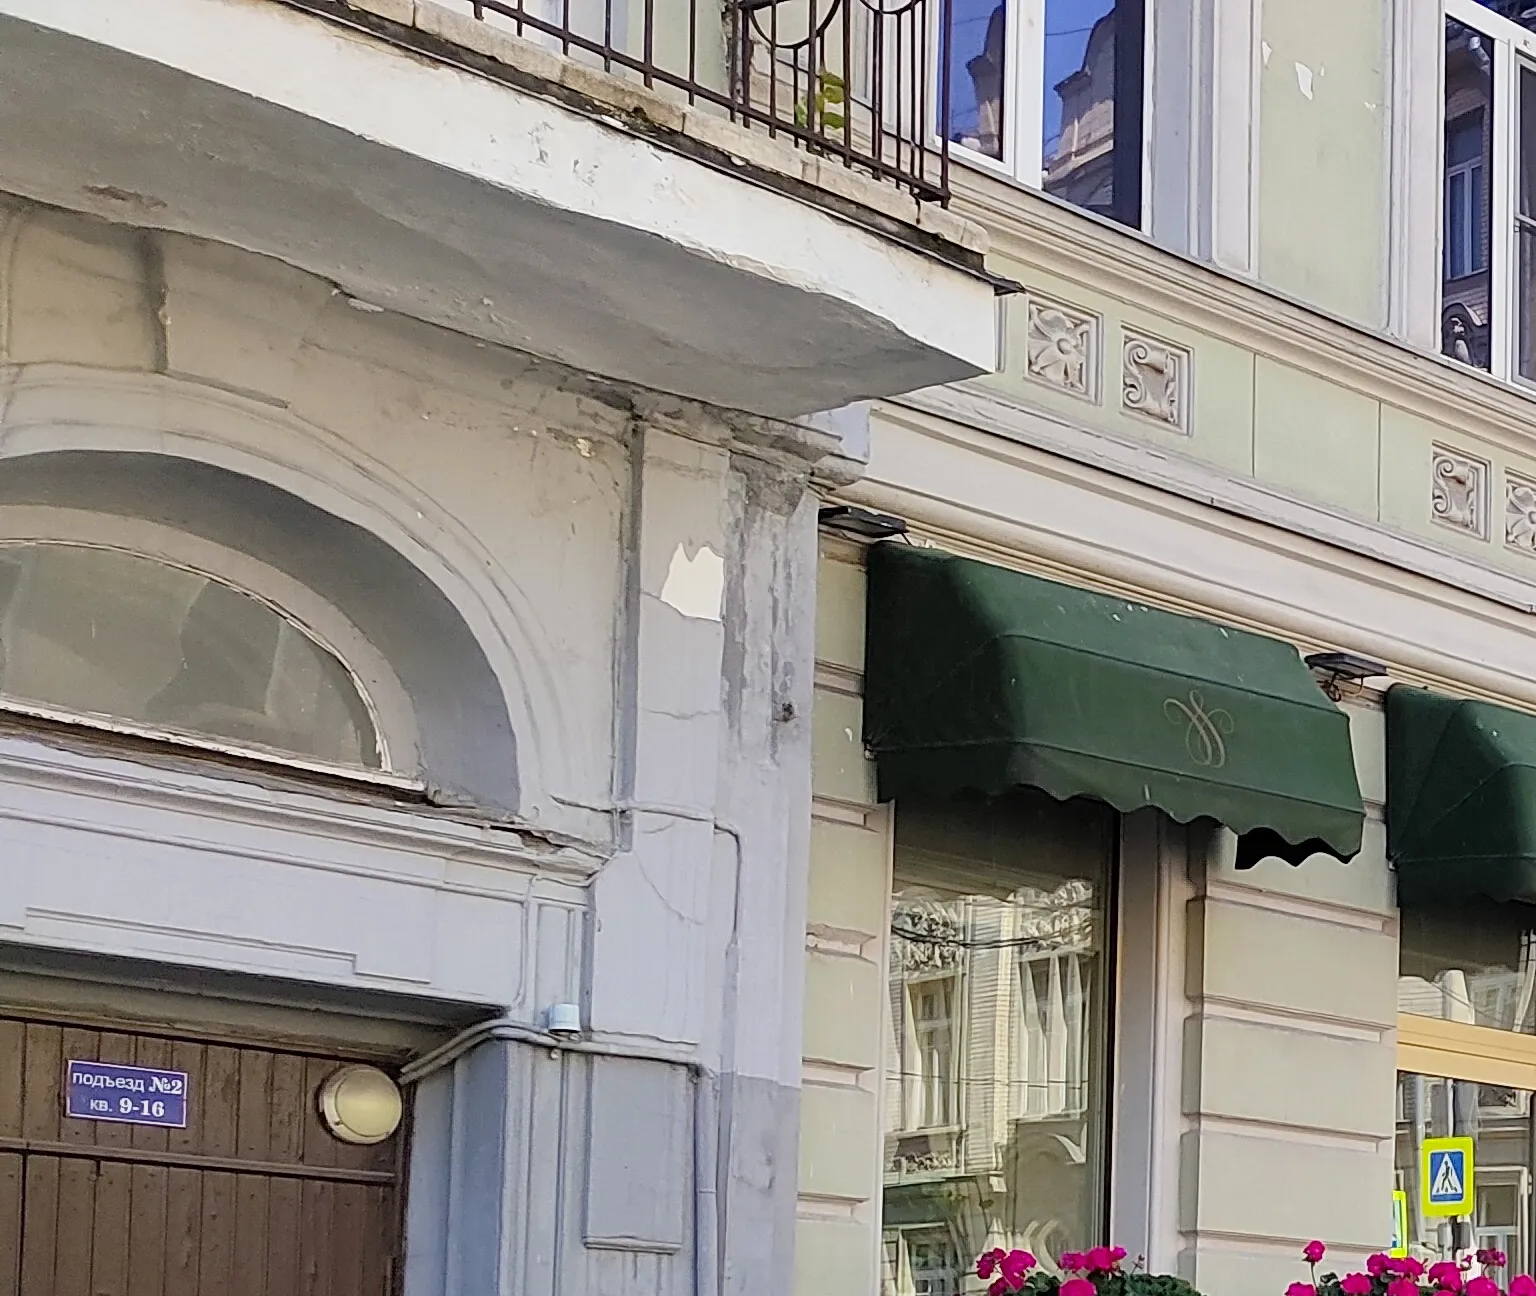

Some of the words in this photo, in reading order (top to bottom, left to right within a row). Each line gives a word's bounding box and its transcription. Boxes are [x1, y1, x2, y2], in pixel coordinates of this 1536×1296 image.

[72, 1072, 145, 1093] подъезд
[148, 1076, 183, 1095] №2
[90, 1099, 113, 1112] кв.
[119, 1097, 165, 1117] 9-16
